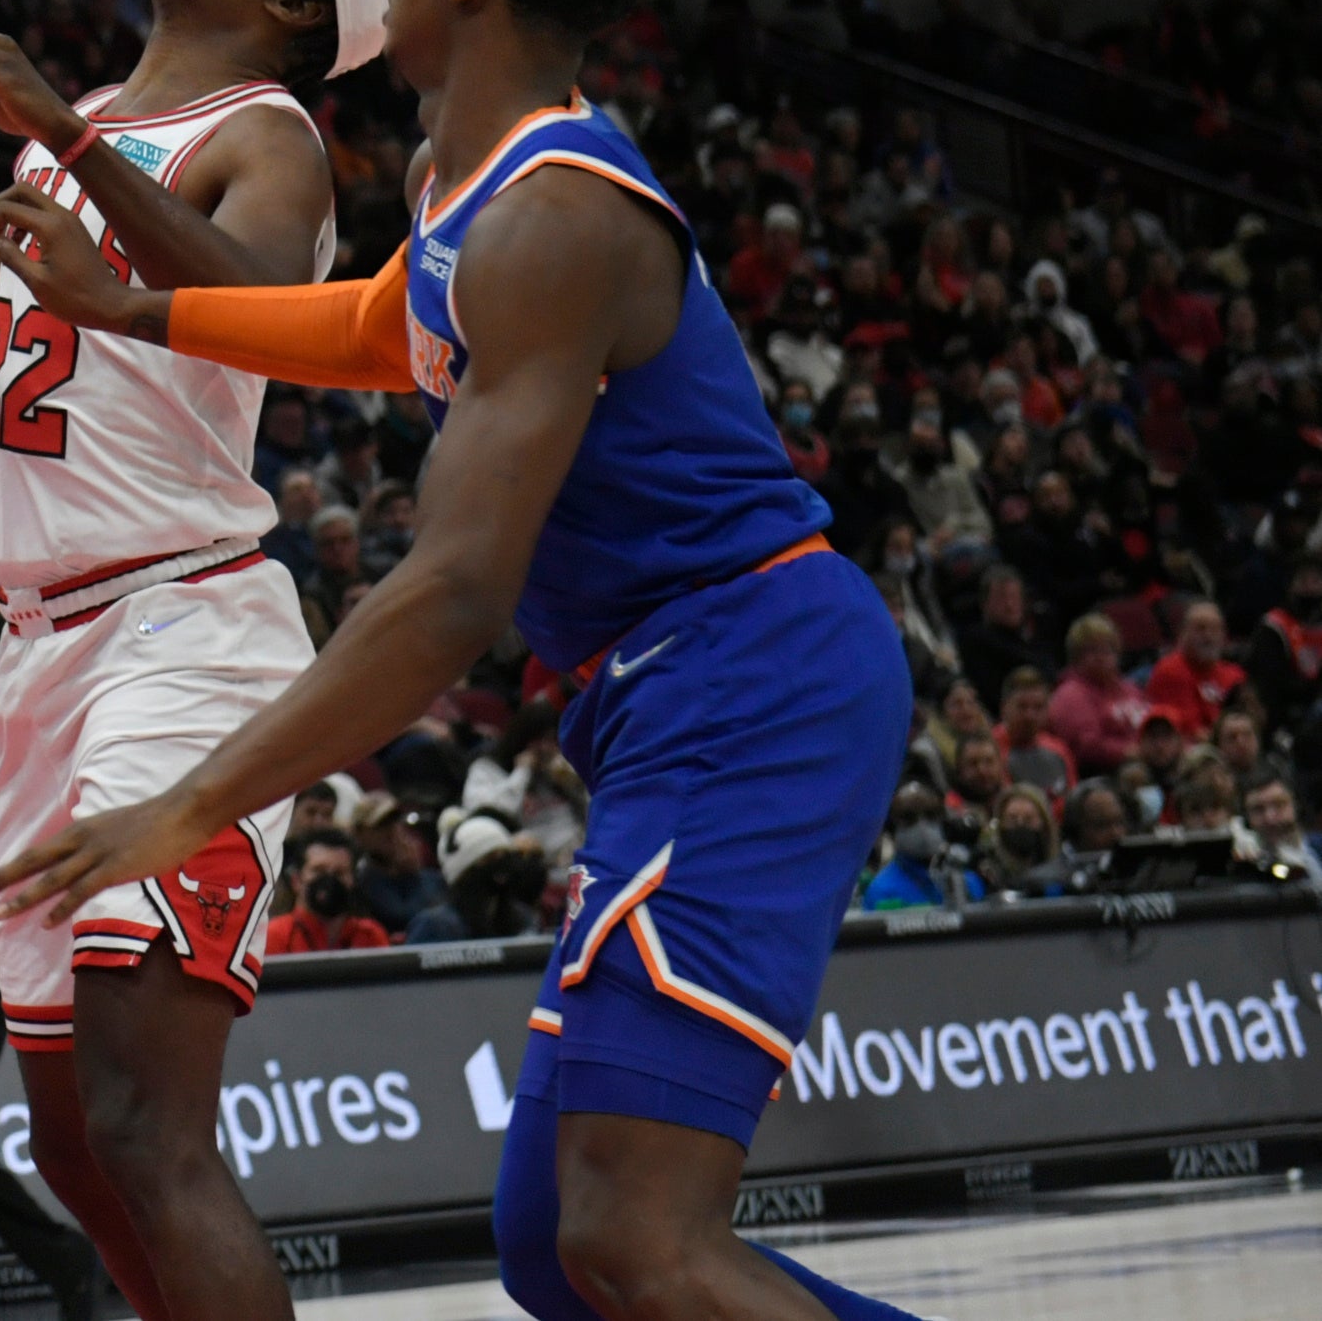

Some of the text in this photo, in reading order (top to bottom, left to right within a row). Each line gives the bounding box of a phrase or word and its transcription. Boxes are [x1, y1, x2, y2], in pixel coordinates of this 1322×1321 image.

[419, 254, 451, 282] SPACE
[790, 980, 1307, 1103] Movement that
[215, 1060, 421, 1179] pires
